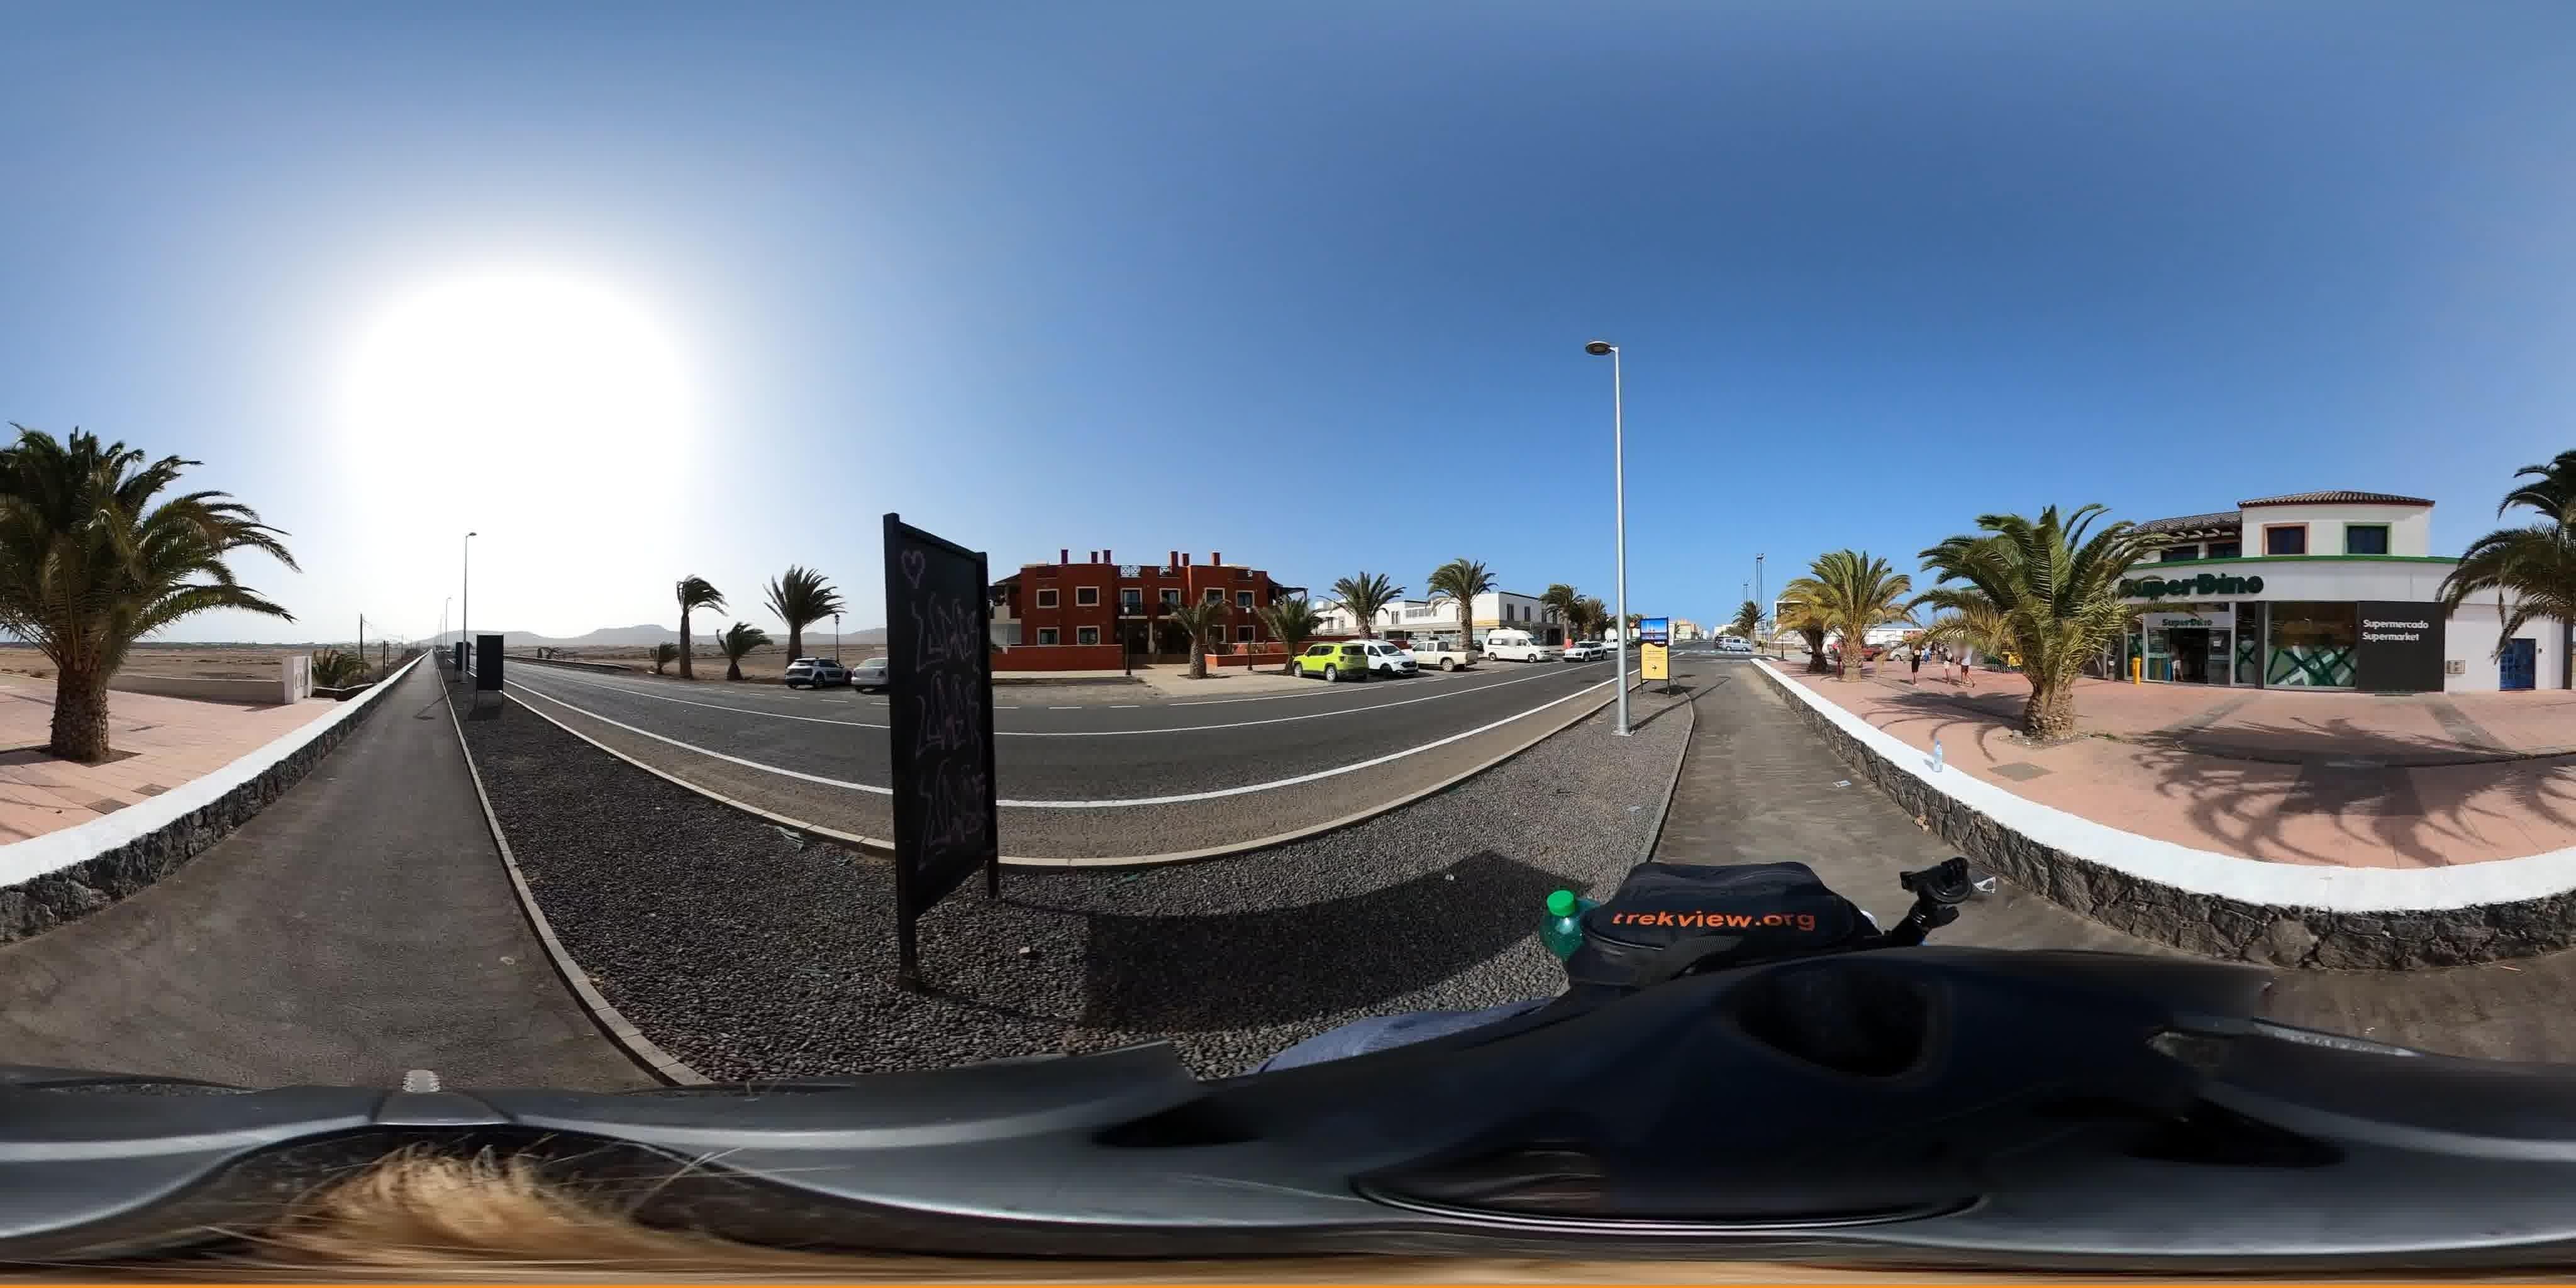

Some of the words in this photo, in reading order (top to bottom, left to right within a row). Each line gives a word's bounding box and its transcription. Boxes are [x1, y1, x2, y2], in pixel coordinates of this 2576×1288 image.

[2363, 619, 2429, 629] Supermercado
[2362, 631, 2420, 642] Supermarket
[1611, 911, 1816, 931] trekview.org
